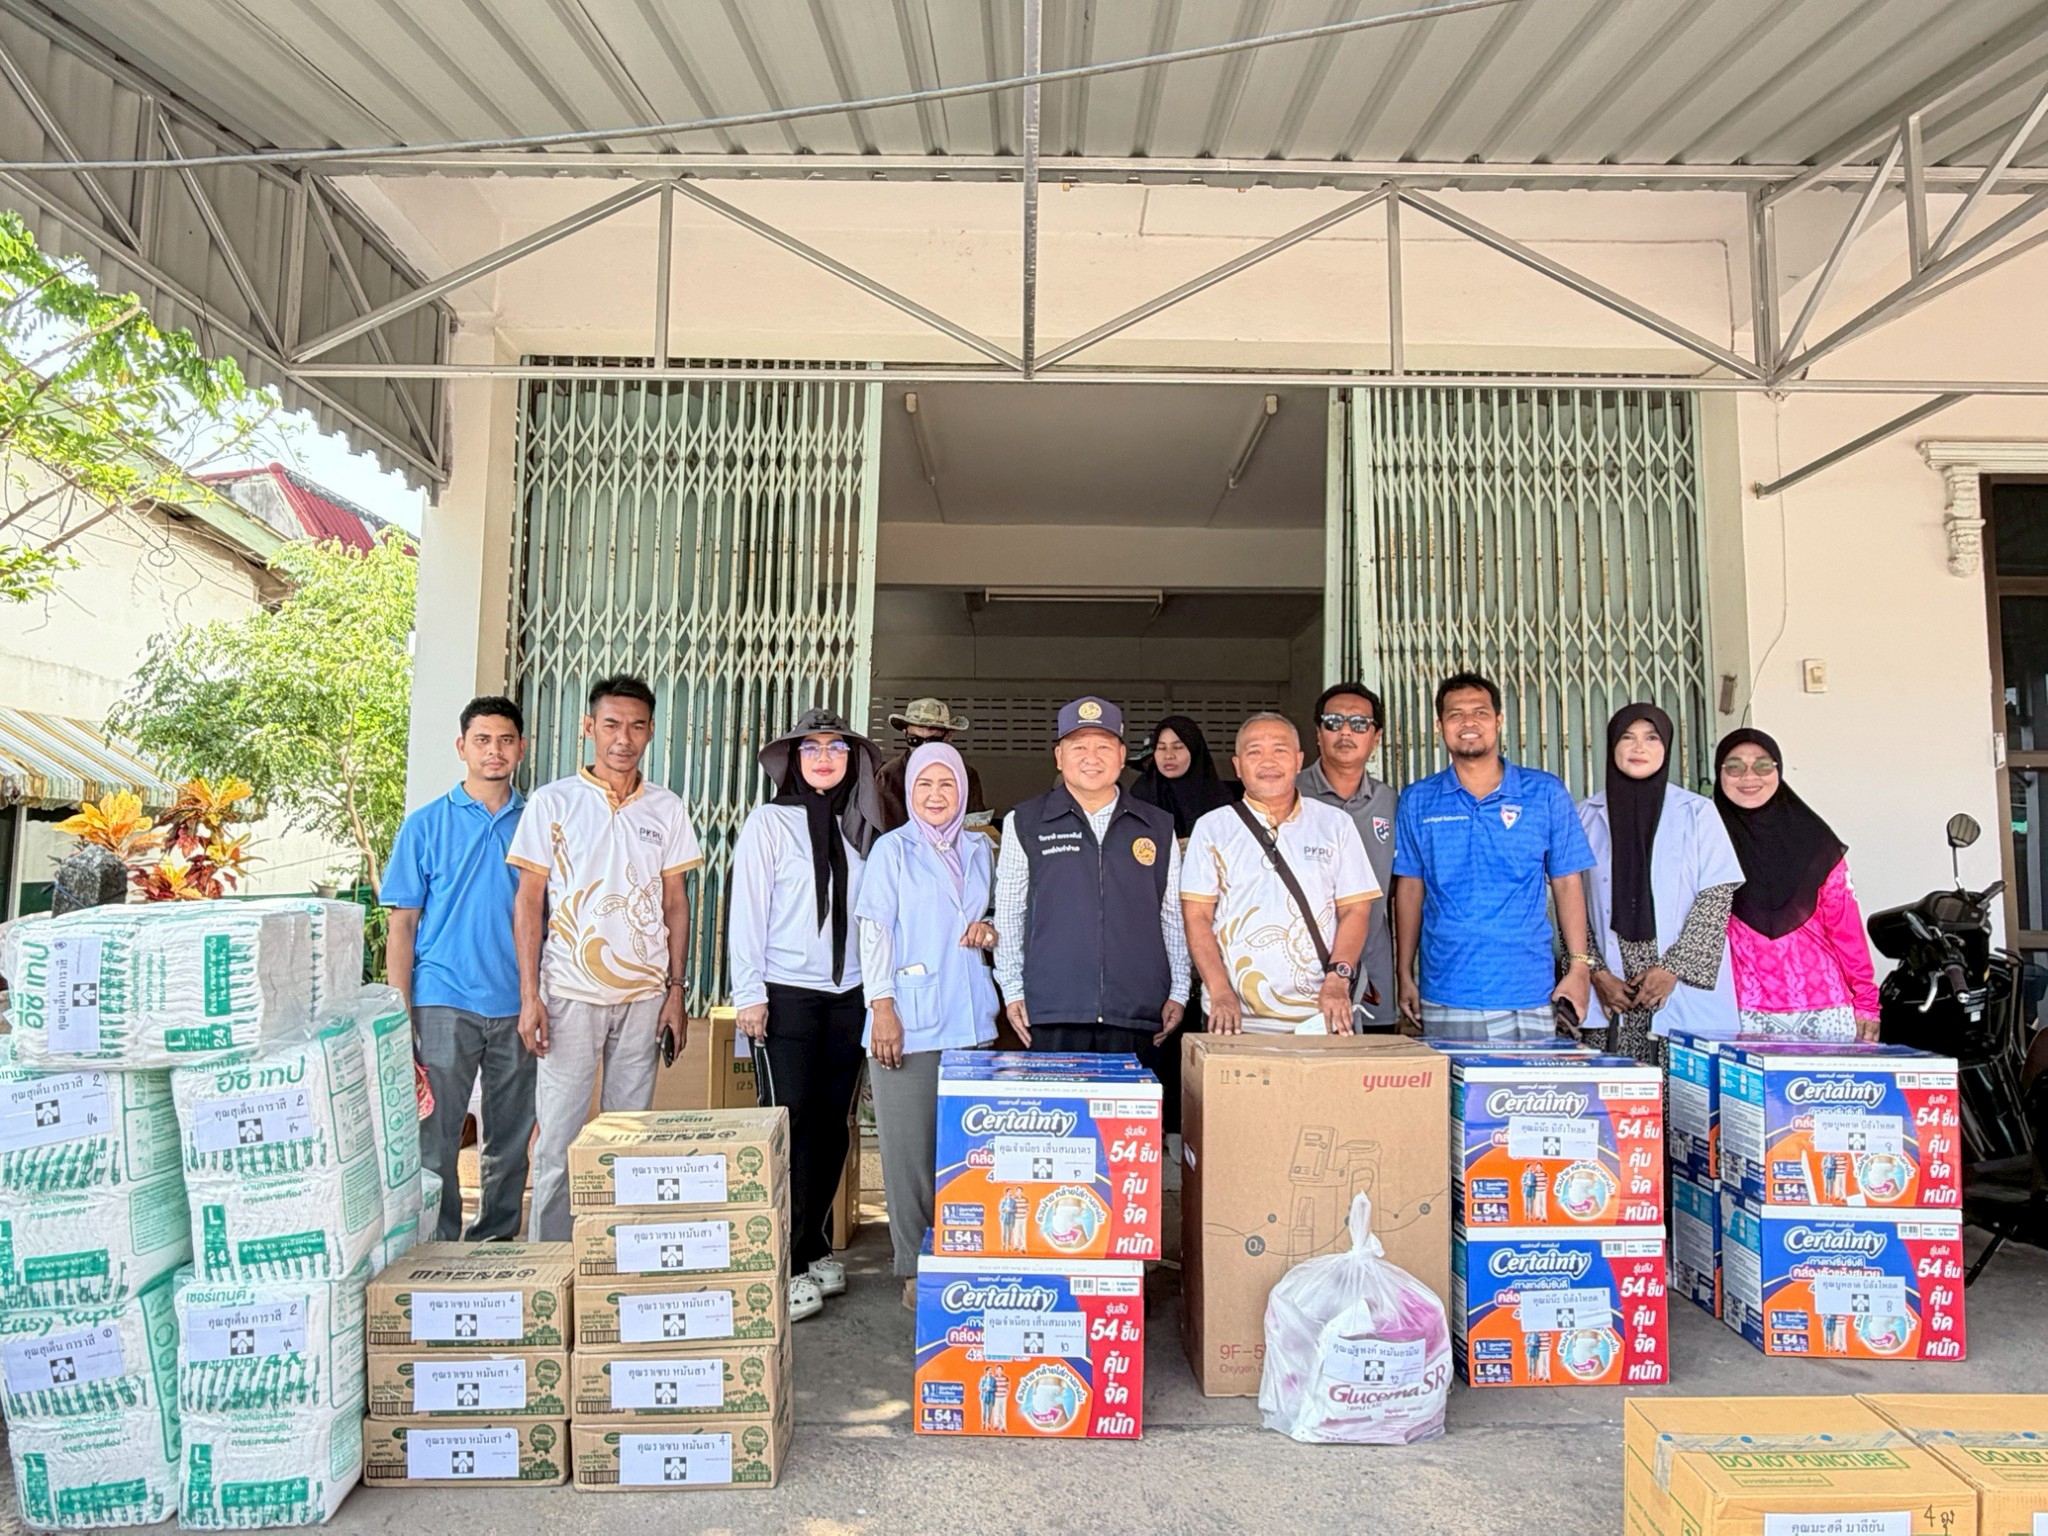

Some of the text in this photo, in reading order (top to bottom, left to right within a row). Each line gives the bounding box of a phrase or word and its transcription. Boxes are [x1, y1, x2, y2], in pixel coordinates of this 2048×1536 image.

[1304, 846, 1333, 857] PKRU
[168, 1034, 186, 1047] L
[213, 1029, 227, 1047] 24
[93, 1073, 103, 1087] 2
[259, 1055, 305, 1087] เทป
[1363, 1071, 1432, 1092] yuwell
[296, 1095, 305, 1106] 2
[1789, 1080, 1882, 1106] Certainty
[1490, 1092, 1585, 1117] Certainty
[965, 1106, 1075, 1136] Certainty
[1916, 1107, 1958, 1126] 54 ชิ้น
[1617, 1119, 1660, 1139] 54 ชิ้น
[1109, 1140, 1158, 1163] 54 ชิ้น
[1928, 1134, 1950, 1158] คุ้ม
[713, 1162, 720, 1171] 4
[1629, 1147, 1651, 1170] คุ้ม
[1929, 1161, 1950, 1178] จัด
[1122, 1172, 1148, 1201] คุ้ม
[1630, 1176, 1651, 1194] จัด
[1775, 1184, 1798, 1194] L 54
[1924, 1185, 1956, 1203] หนัก
[208, 1207, 221, 1225] L
[1123, 1203, 1148, 1224] จัด
[1474, 1205, 1498, 1214] L 54
[1625, 1203, 1658, 1221] หนัก
[716, 1224, 722, 1232] 4
[945, 1230, 971, 1242] L 54
[1116, 1232, 1154, 1254] หนัก
[1788, 1230, 1883, 1257] Certainty
[207, 1249, 226, 1264] 24
[1492, 1251, 1588, 1278] Certainty
[1917, 1259, 1960, 1278] 54 ชิ้น
[945, 1282, 1054, 1311] Certainty
[1621, 1278, 1663, 1297] 54 ชิ้น
[510, 1295, 516, 1303] 4
[1930, 1286, 1953, 1311] คุ้ม
[290, 1304, 298, 1315] 2
[1633, 1305, 1656, 1331] คุ้ม
[1090, 1318, 1140, 1341] 54 ชิ้น
[1931, 1314, 1953, 1331] จัด
[1633, 1335, 1655, 1353] จัด
[1773, 1335, 1798, 1344] L 54
[1926, 1338, 1959, 1357] หนัก
[1220, 1344, 1266, 1360] 9F-5
[513, 1364, 520, 1373] 4
[709, 1362, 716, 1372] 4
[1103, 1352, 1129, 1381] คุ้ม
[1220, 1364, 1257, 1375] Oxygen
[1476, 1364, 1500, 1375] L 54
[1628, 1360, 1662, 1380] หนัก
[1329, 1363, 1446, 1404] Glucerna SR
[1104, 1384, 1128, 1405] จัด
[924, 1409, 951, 1422] L 54
[1096, 1413, 1135, 1435] หนัก
[505, 1431, 513, 1440] 4
[719, 1435, 726, 1446] 4
[195, 1447, 206, 1463] L
[1717, 1452, 1897, 1468] DO NOT PUNCTURE
[1971, 1449, 2009, 1462] DO
[1924, 1504, 1936, 1527] 4
